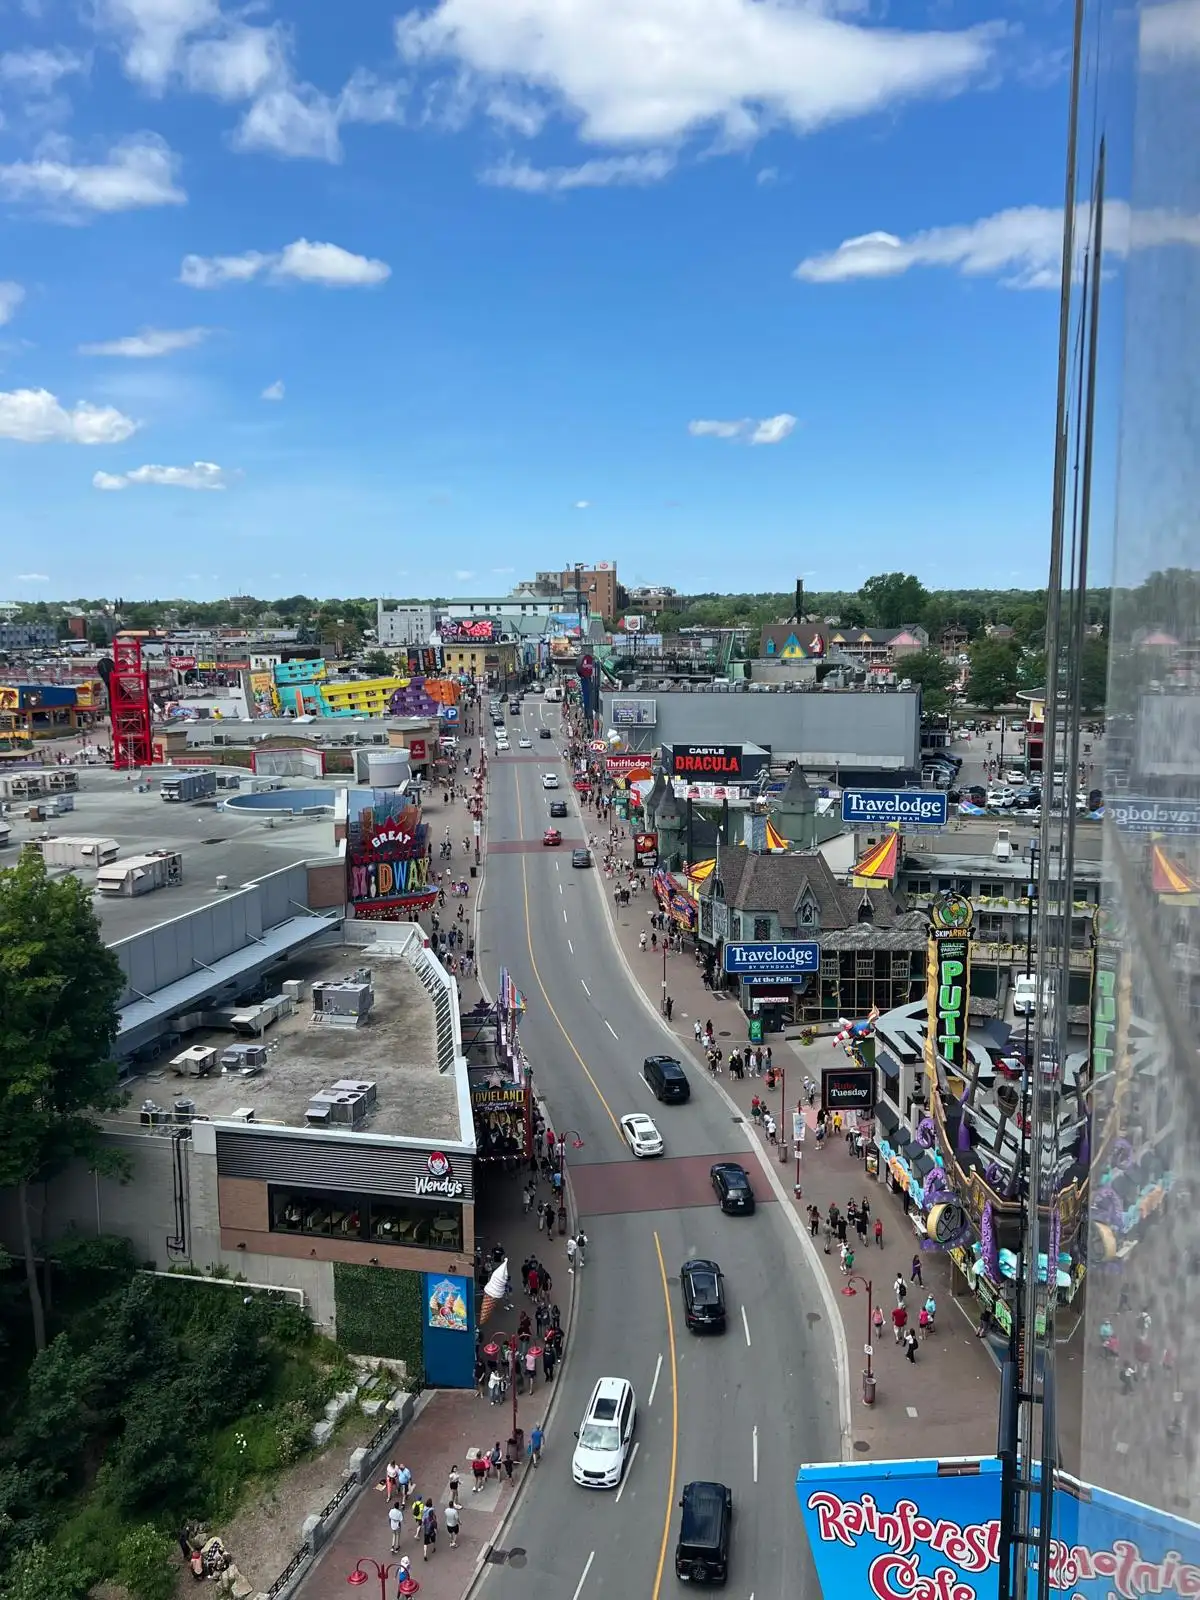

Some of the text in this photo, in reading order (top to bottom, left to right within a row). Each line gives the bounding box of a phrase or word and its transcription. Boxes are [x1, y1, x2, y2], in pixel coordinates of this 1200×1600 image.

[448, 709, 457, 719] P
[592, 743, 605, 751] DQ
[606, 759, 650, 769] Thriftlodge
[675, 756, 739, 773] DRACULA
[848, 793, 942, 817] Travelodge
[371, 830, 412, 848] GREAT
[731, 946, 813, 966] Travelodge
[938, 960, 964, 1060] PUTT
[830, 1089, 868, 1098] Tuesday
[415, 1176, 463, 1198] Wendy's
[807, 1490, 1001, 1573] Rainforest
[868, 1553, 977, 1600] Cafe
